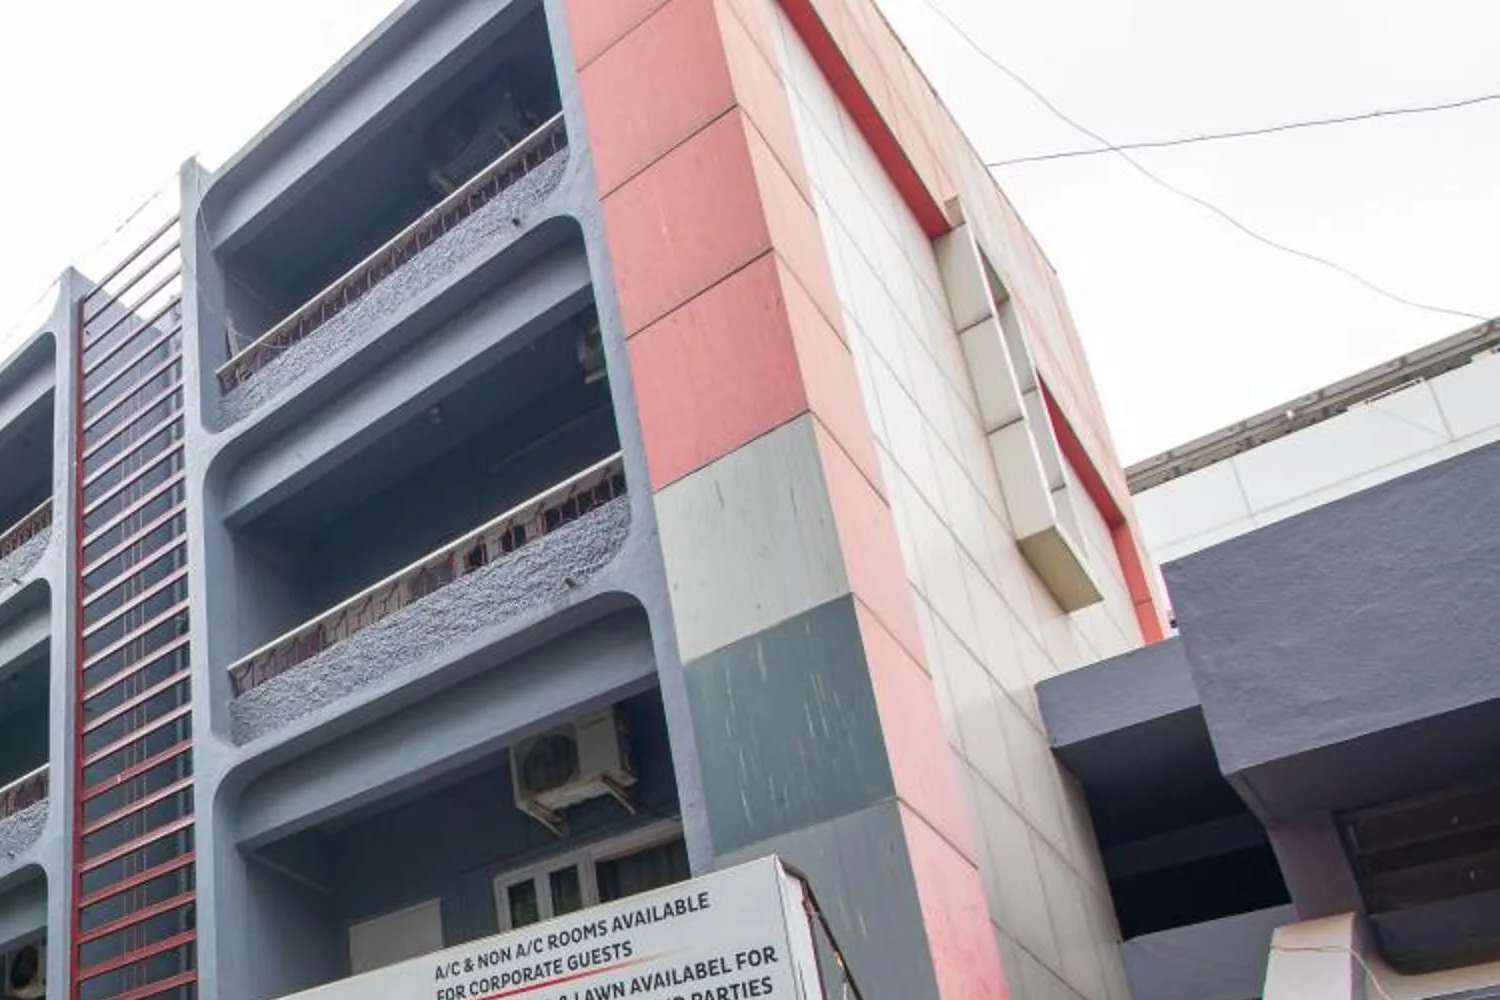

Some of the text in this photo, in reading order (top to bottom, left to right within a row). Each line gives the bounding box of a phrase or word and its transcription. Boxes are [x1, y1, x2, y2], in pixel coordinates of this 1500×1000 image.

[435, 891, 711, 981] A/C & NON A/C ROOMS AVAILABLE
[469, 957, 564, 997] CORPORATE
[566, 939, 634, 972] GUESTS
[630, 957, 732, 995] AVAILABEL
[735, 945, 779, 971] FOR
